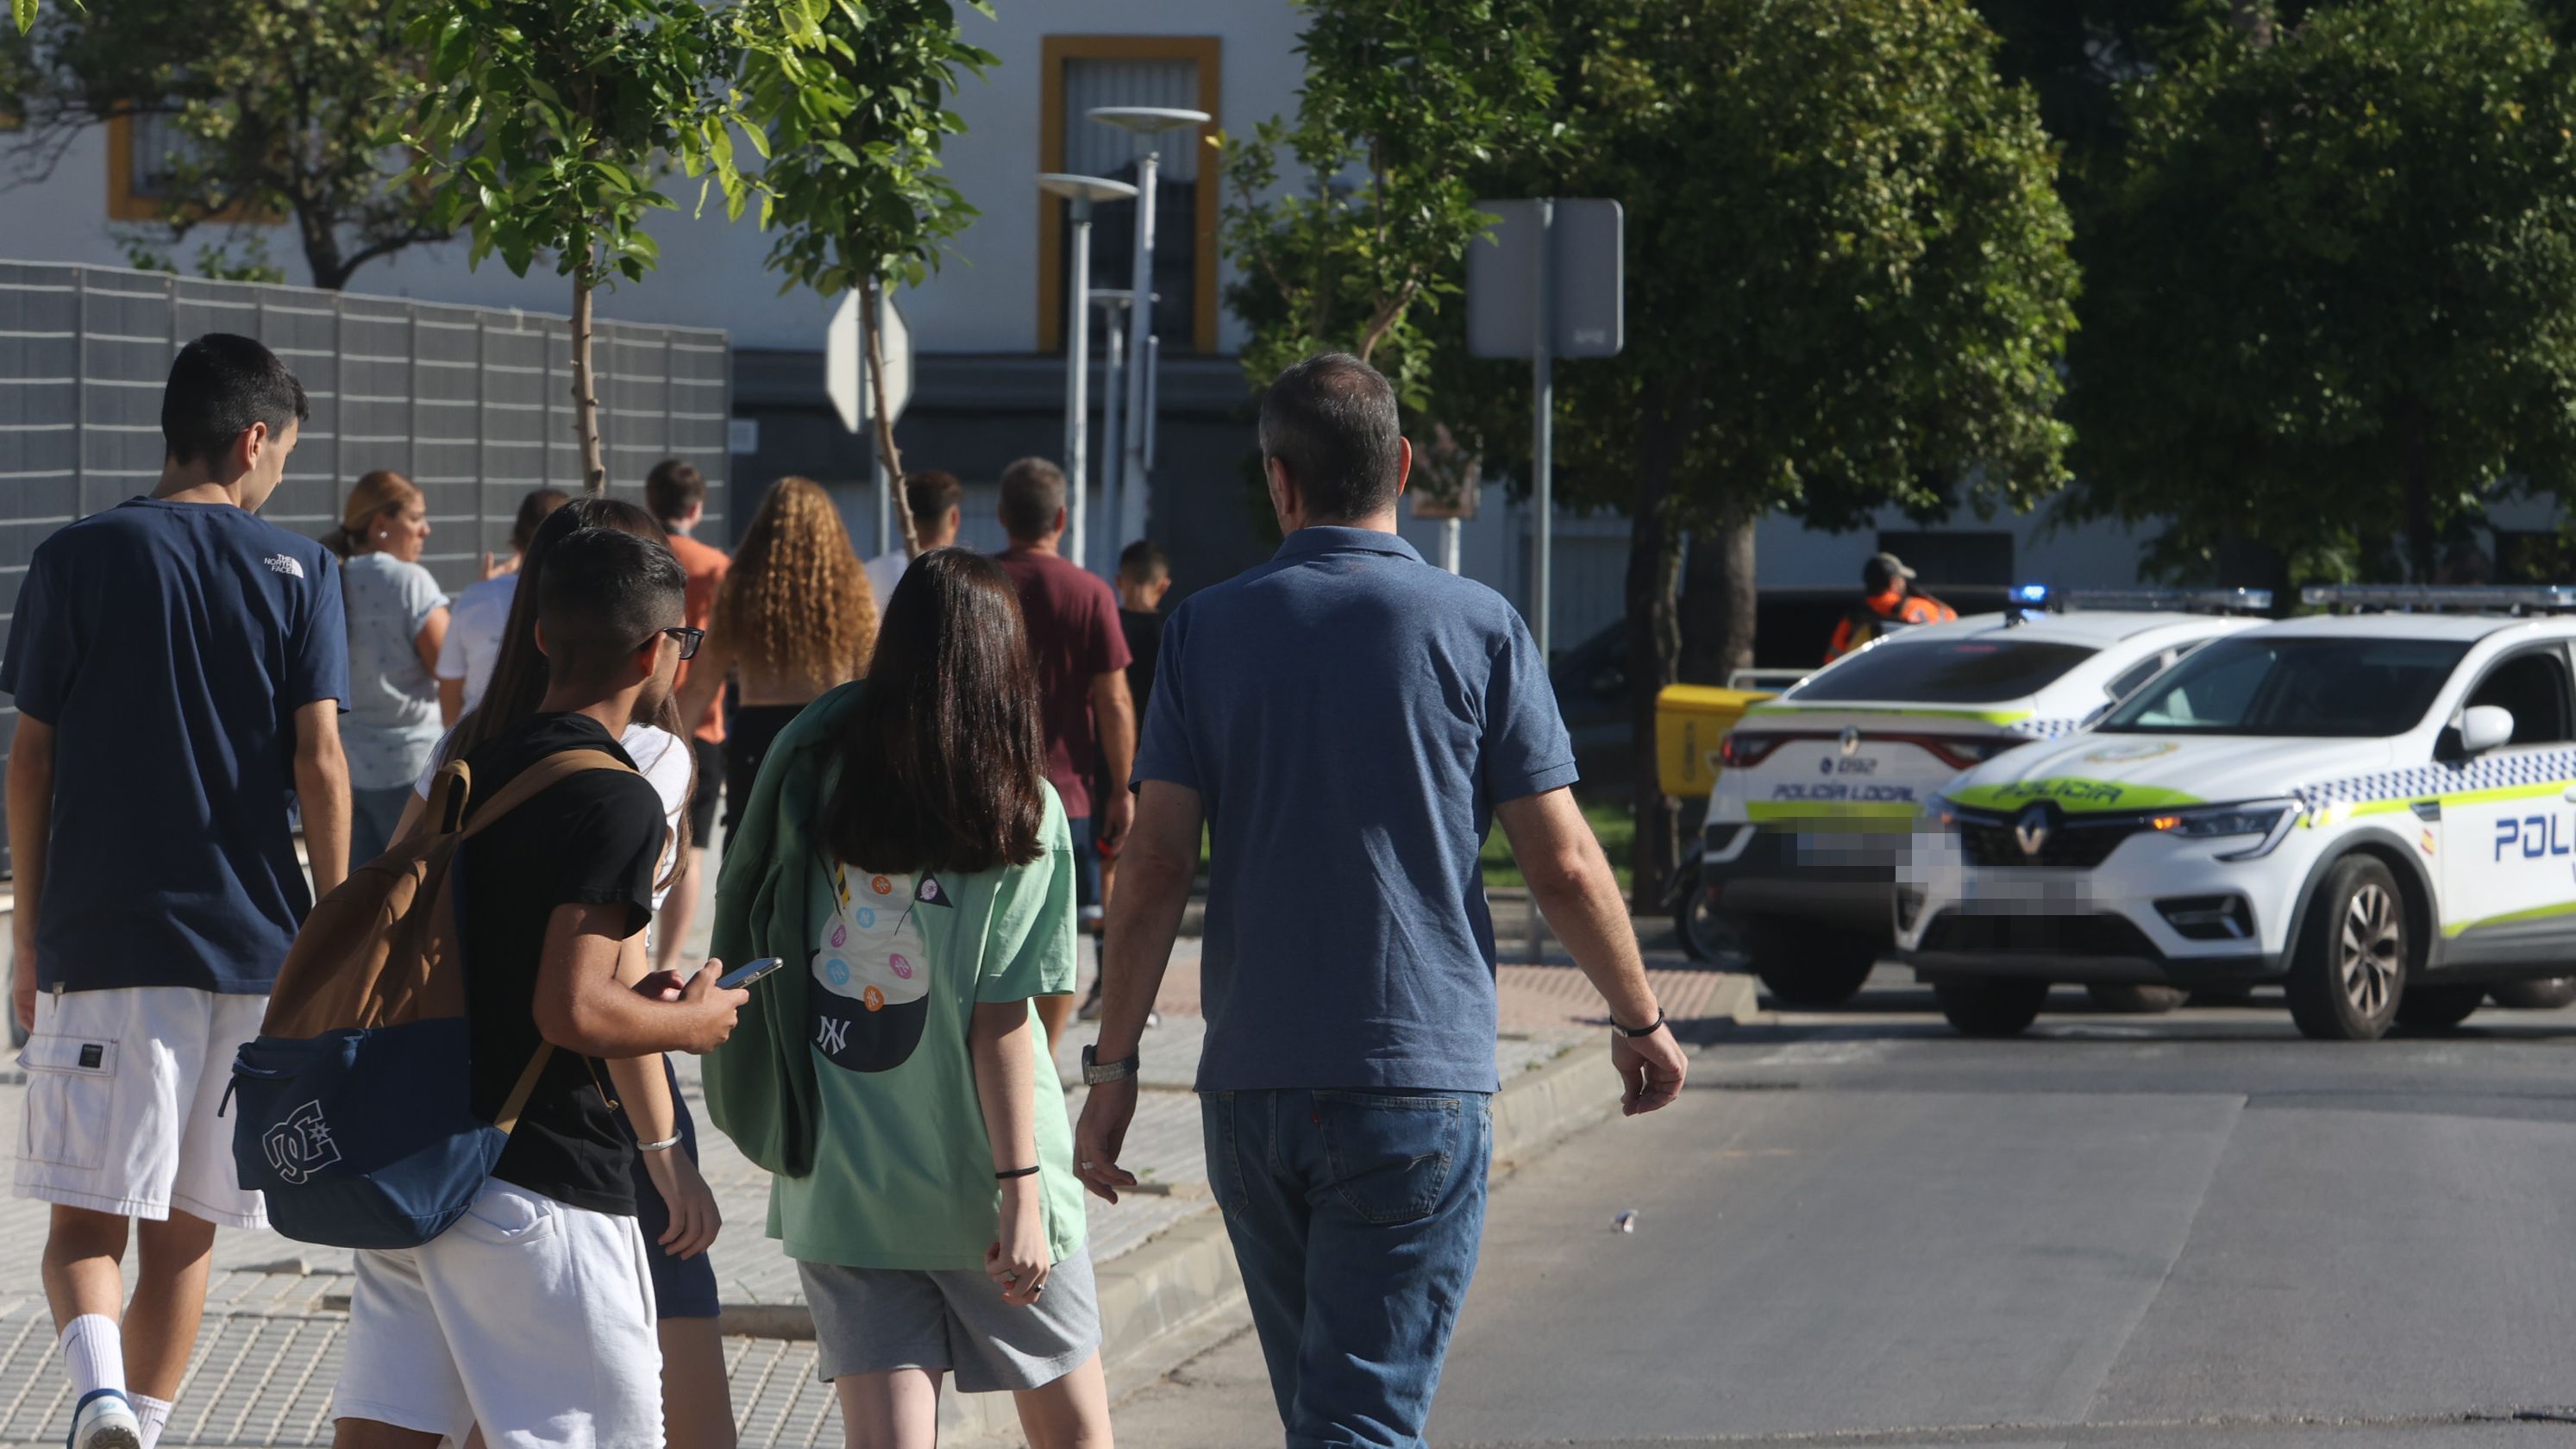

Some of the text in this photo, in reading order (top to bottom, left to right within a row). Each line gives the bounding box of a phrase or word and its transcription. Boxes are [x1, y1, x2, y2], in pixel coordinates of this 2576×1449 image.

[264, 557, 291, 568] NORTH
[276, 553, 291, 561] THE
[271, 565, 291, 574] FACE
[1838, 758, 1878, 774] 092
[1851, 785, 1918, 802] LOCAL
[816, 1015, 851, 1056] NY
